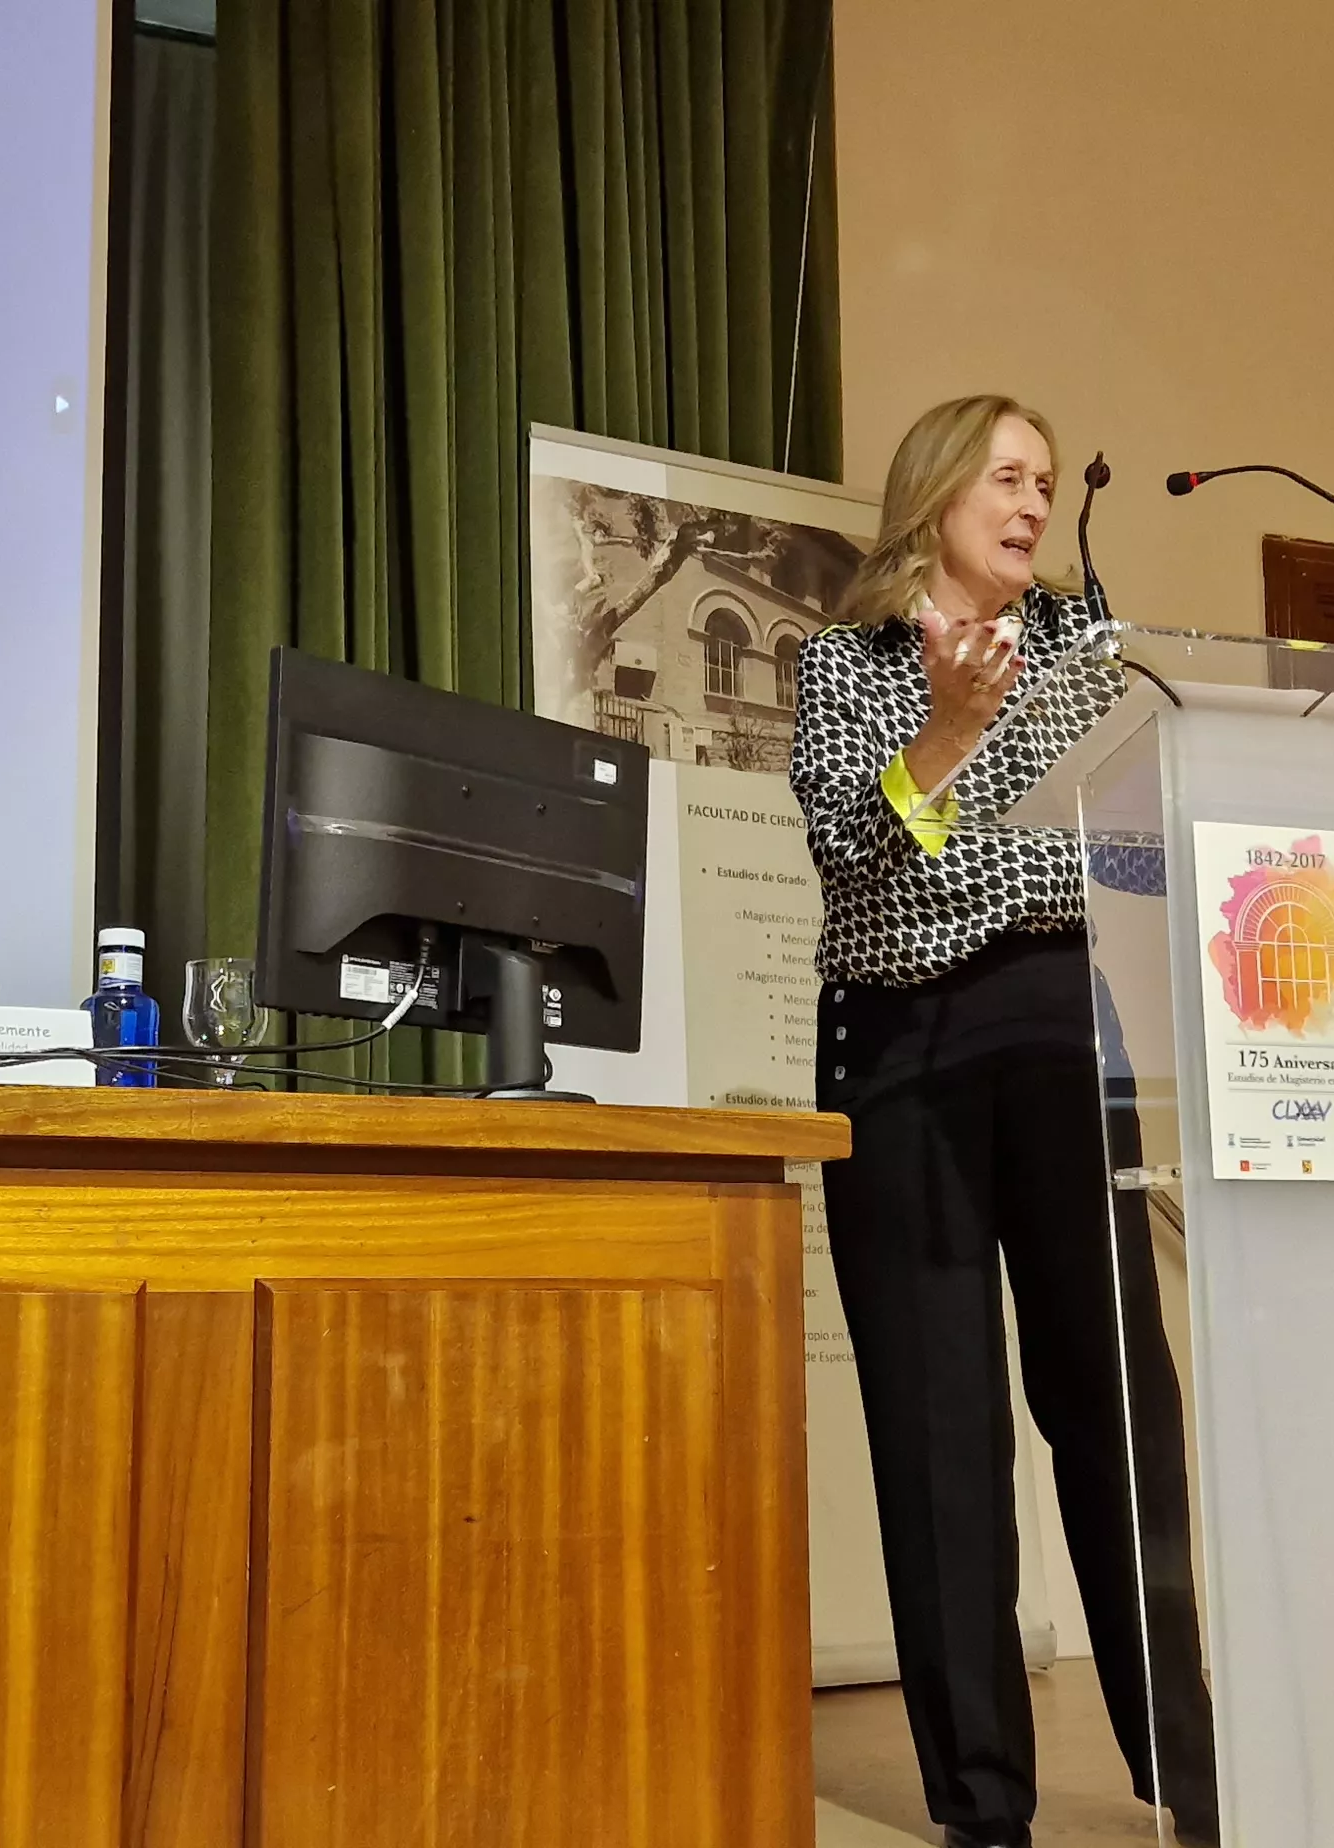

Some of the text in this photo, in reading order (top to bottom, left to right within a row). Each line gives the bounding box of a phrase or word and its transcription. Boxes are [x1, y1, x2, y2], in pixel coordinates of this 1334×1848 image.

[687, 804, 749, 822] FACULTAD
[752, 811, 767, 825] DE
[1245, 849, 1326, 869] 1842-2017
[717, 866, 811, 888] Estudios de Grado:
[743, 908, 795, 924] Magisterio
[797, 917, 809, 927] en
[745, 970, 797, 985] Magisterio
[799, 977, 811, 987] en
[1238, 1050, 1269, 1068] 175
[1227, 1071, 1264, 1083] Estudios
[1267, 1074, 1277, 1084] de
[1280, 1074, 1326, 1087] Magisterio
[725, 1093, 768, 1106] Estudios
[770, 1096, 783, 1107] de
[831, 1332, 844, 1341] en
